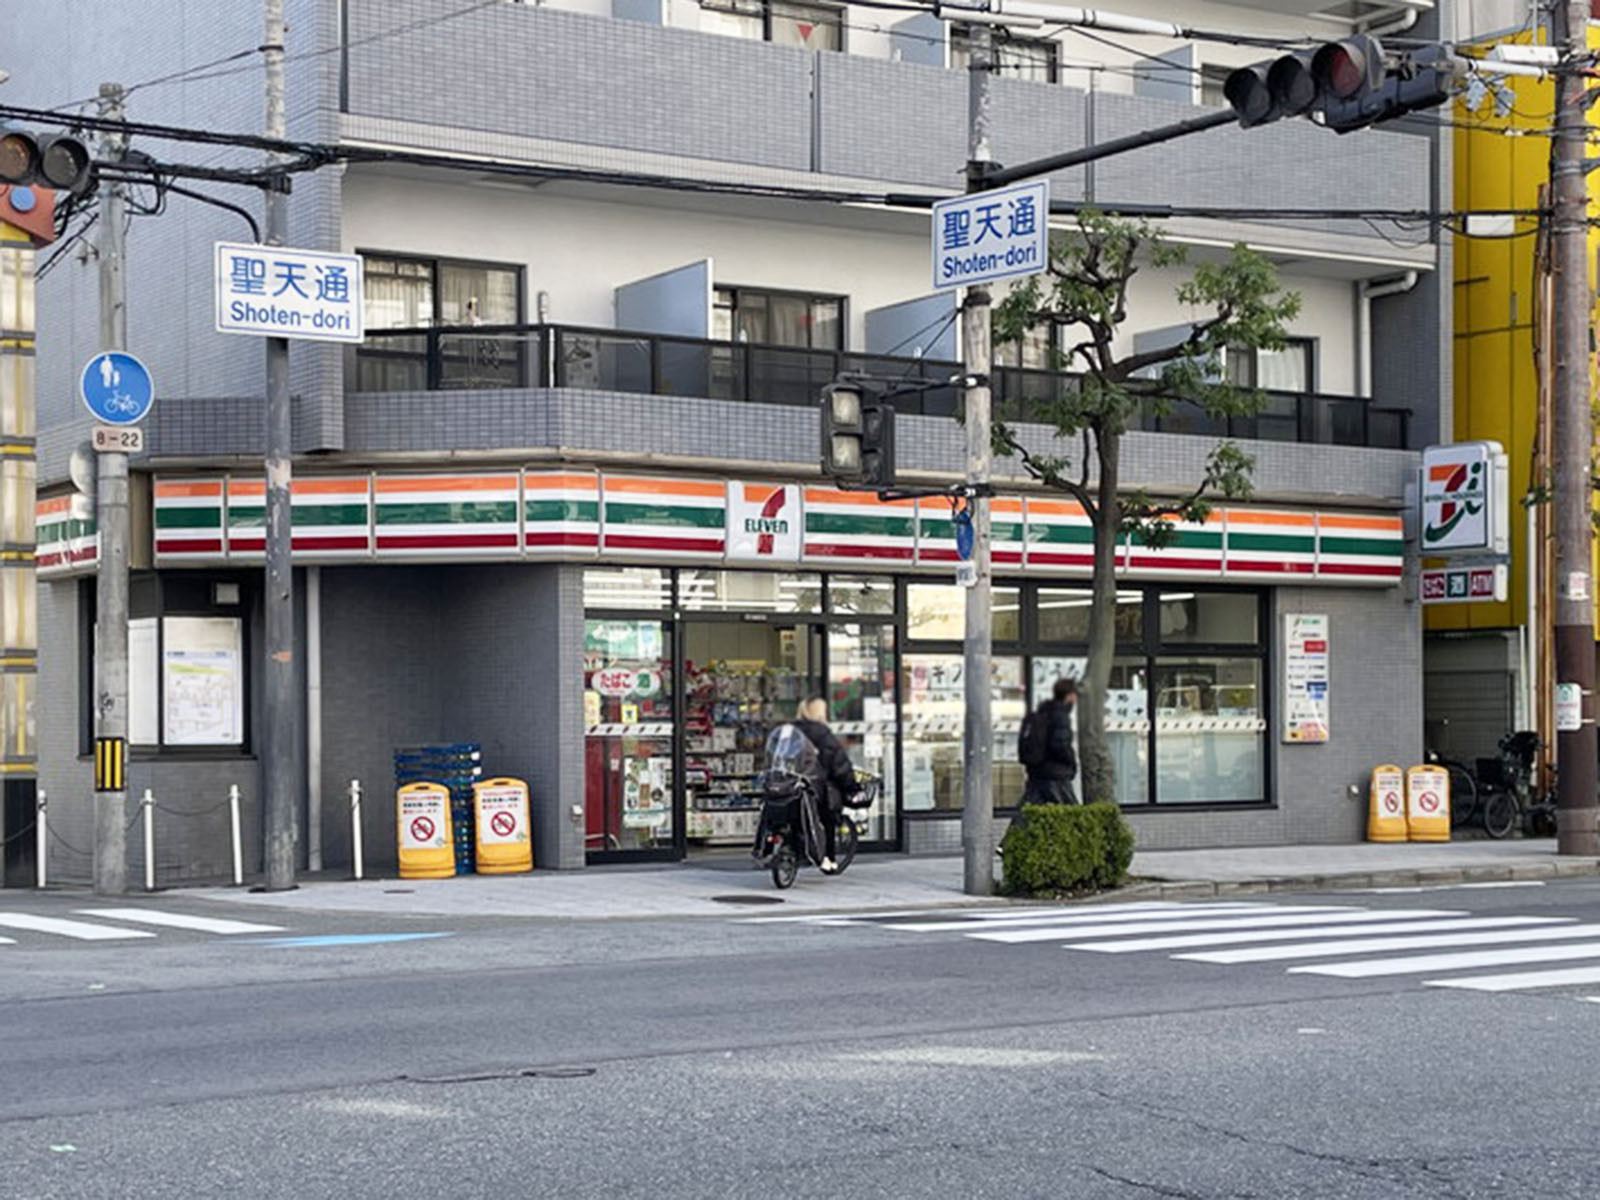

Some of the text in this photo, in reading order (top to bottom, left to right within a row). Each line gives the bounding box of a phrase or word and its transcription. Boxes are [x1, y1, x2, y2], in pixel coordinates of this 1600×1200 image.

[943, 196, 1036, 250] 聖天通
[943, 241, 1037, 278] Shoten-dori
[230, 256, 350, 303] 聖天通
[231, 301, 350, 329] Shoten-dori
[96, 431, 139, 447] 8-22
